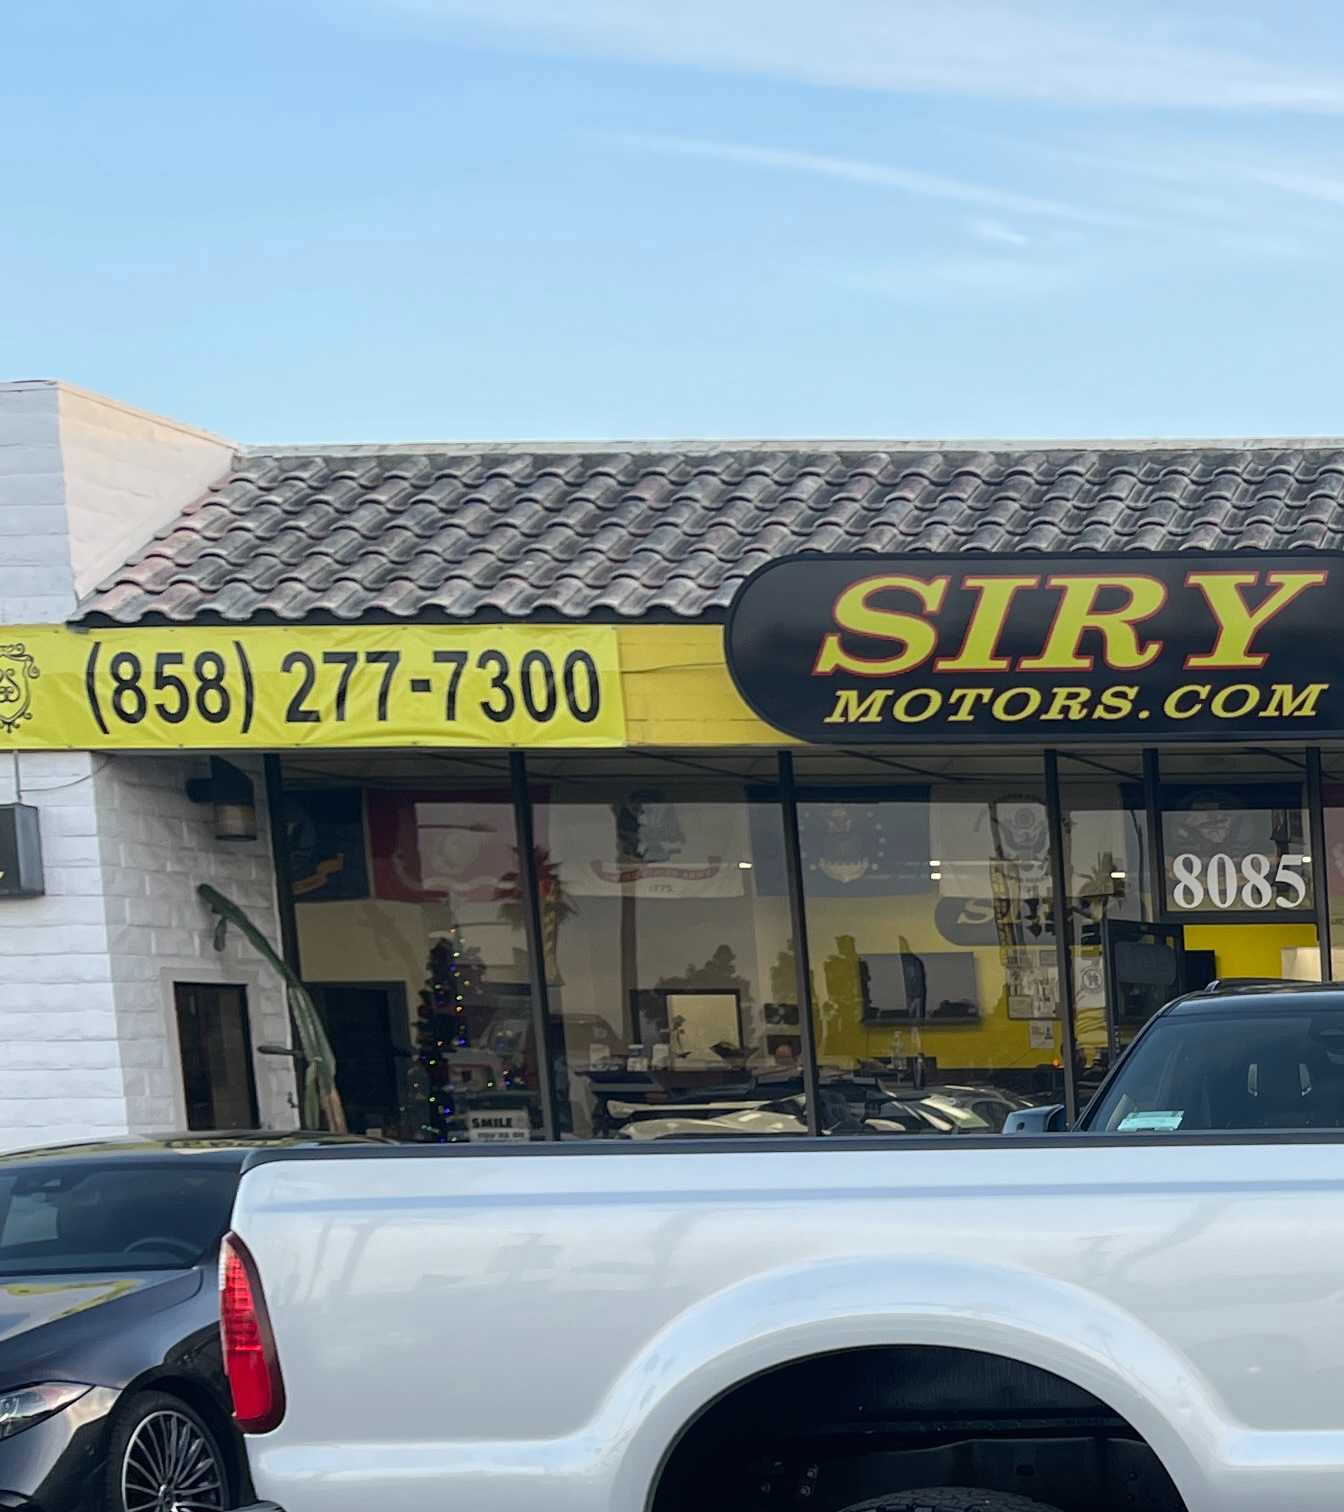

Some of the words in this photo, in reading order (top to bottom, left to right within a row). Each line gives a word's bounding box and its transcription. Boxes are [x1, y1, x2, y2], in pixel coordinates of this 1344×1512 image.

[811, 570, 1328, 678] SIRY
[85, 641, 255, 735] (858)
[280, 648, 601, 724] 277-7300
[823, 683, 1329, 723] MOTORS.COM
[1173, 852, 1306, 909] 8085
[472, 1117, 512, 1128] SMILE
